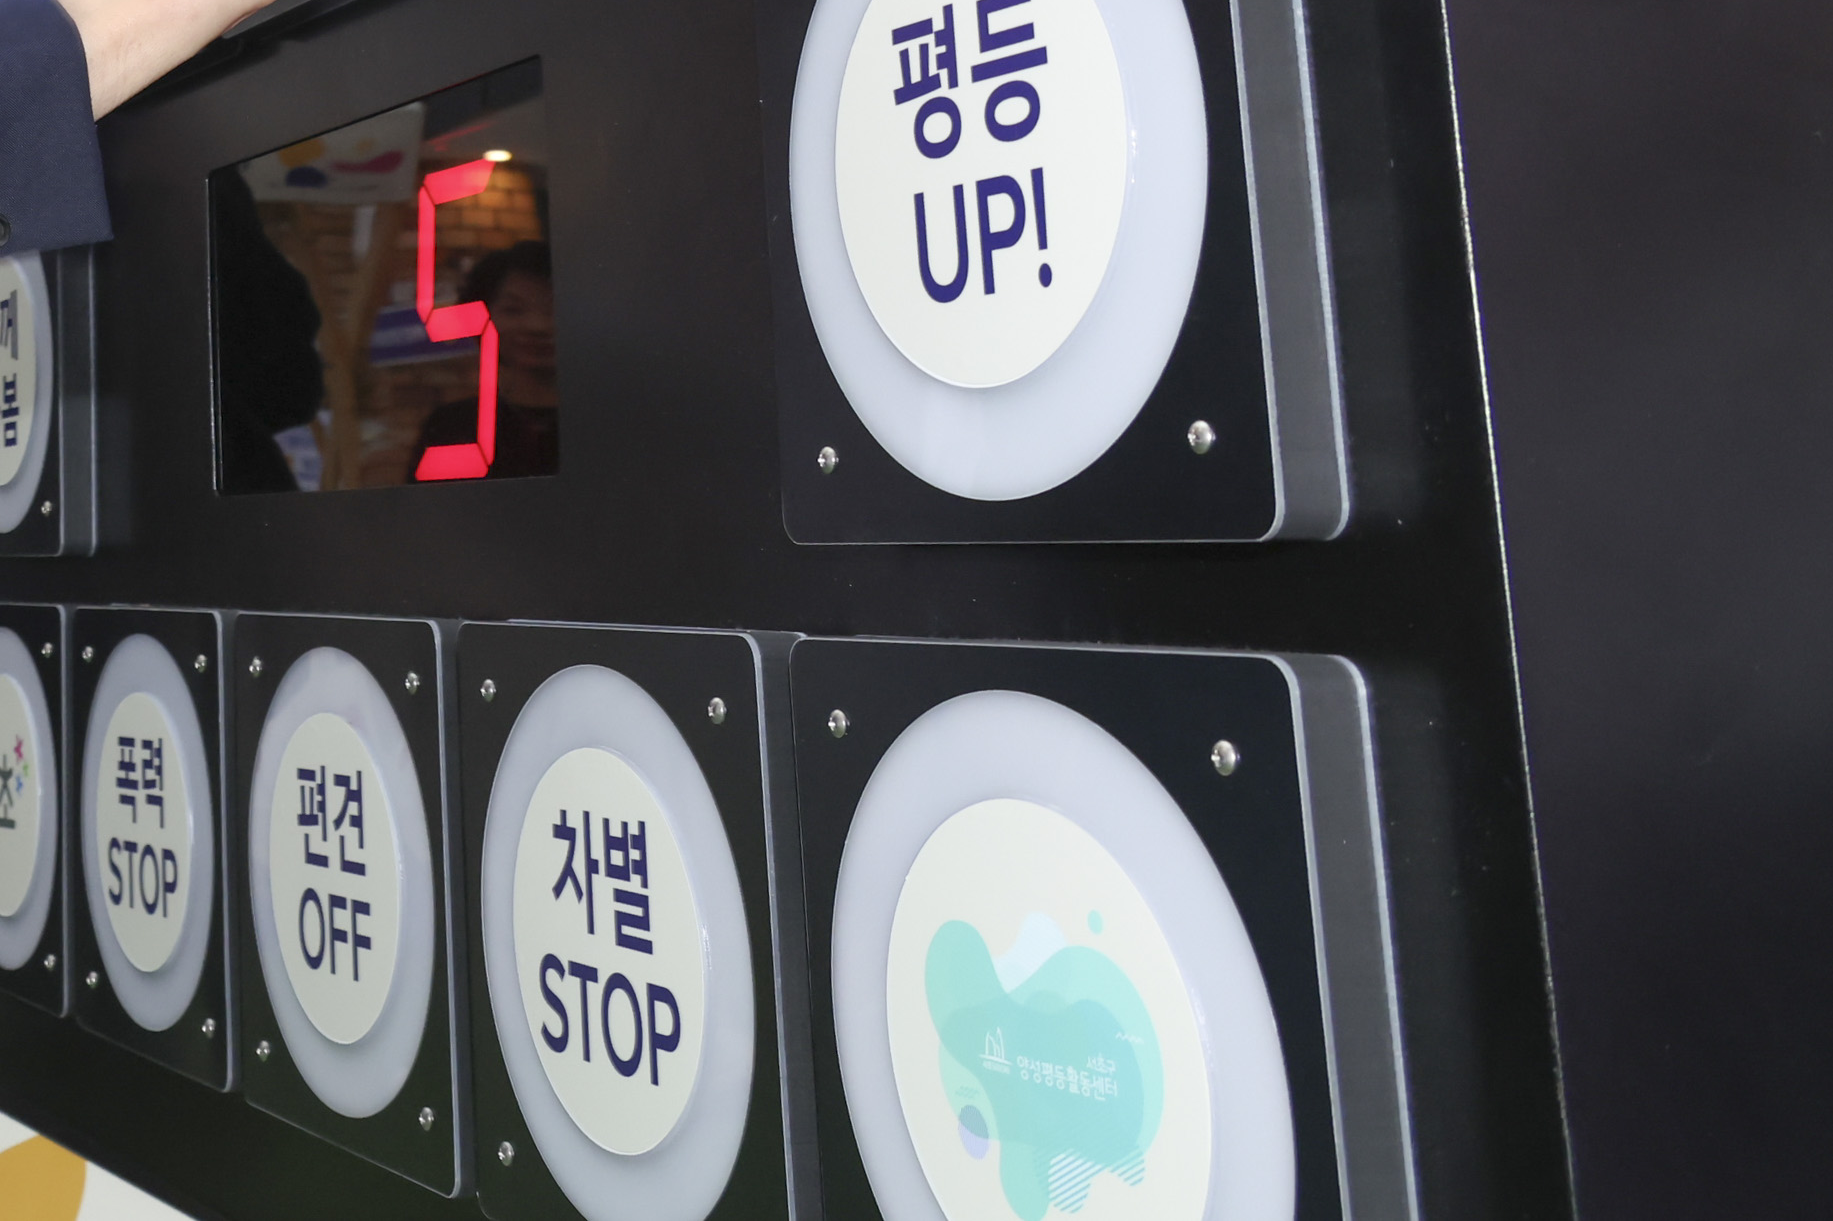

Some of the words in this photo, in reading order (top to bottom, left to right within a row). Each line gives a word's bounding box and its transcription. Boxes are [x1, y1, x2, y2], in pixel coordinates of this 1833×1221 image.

[914, 167, 1053, 303] UP!
[414, 158, 499, 481] 5
[116, 736, 164, 829] 폭력
[296, 765, 366, 876] 편견
[108, 837, 178, 918] STOP
[552, 809, 653, 954] 차별
[298, 888, 372, 982] OFF
[539, 953, 681, 1086] STOP
[1086, 1053, 1117, 1075] 서초구
